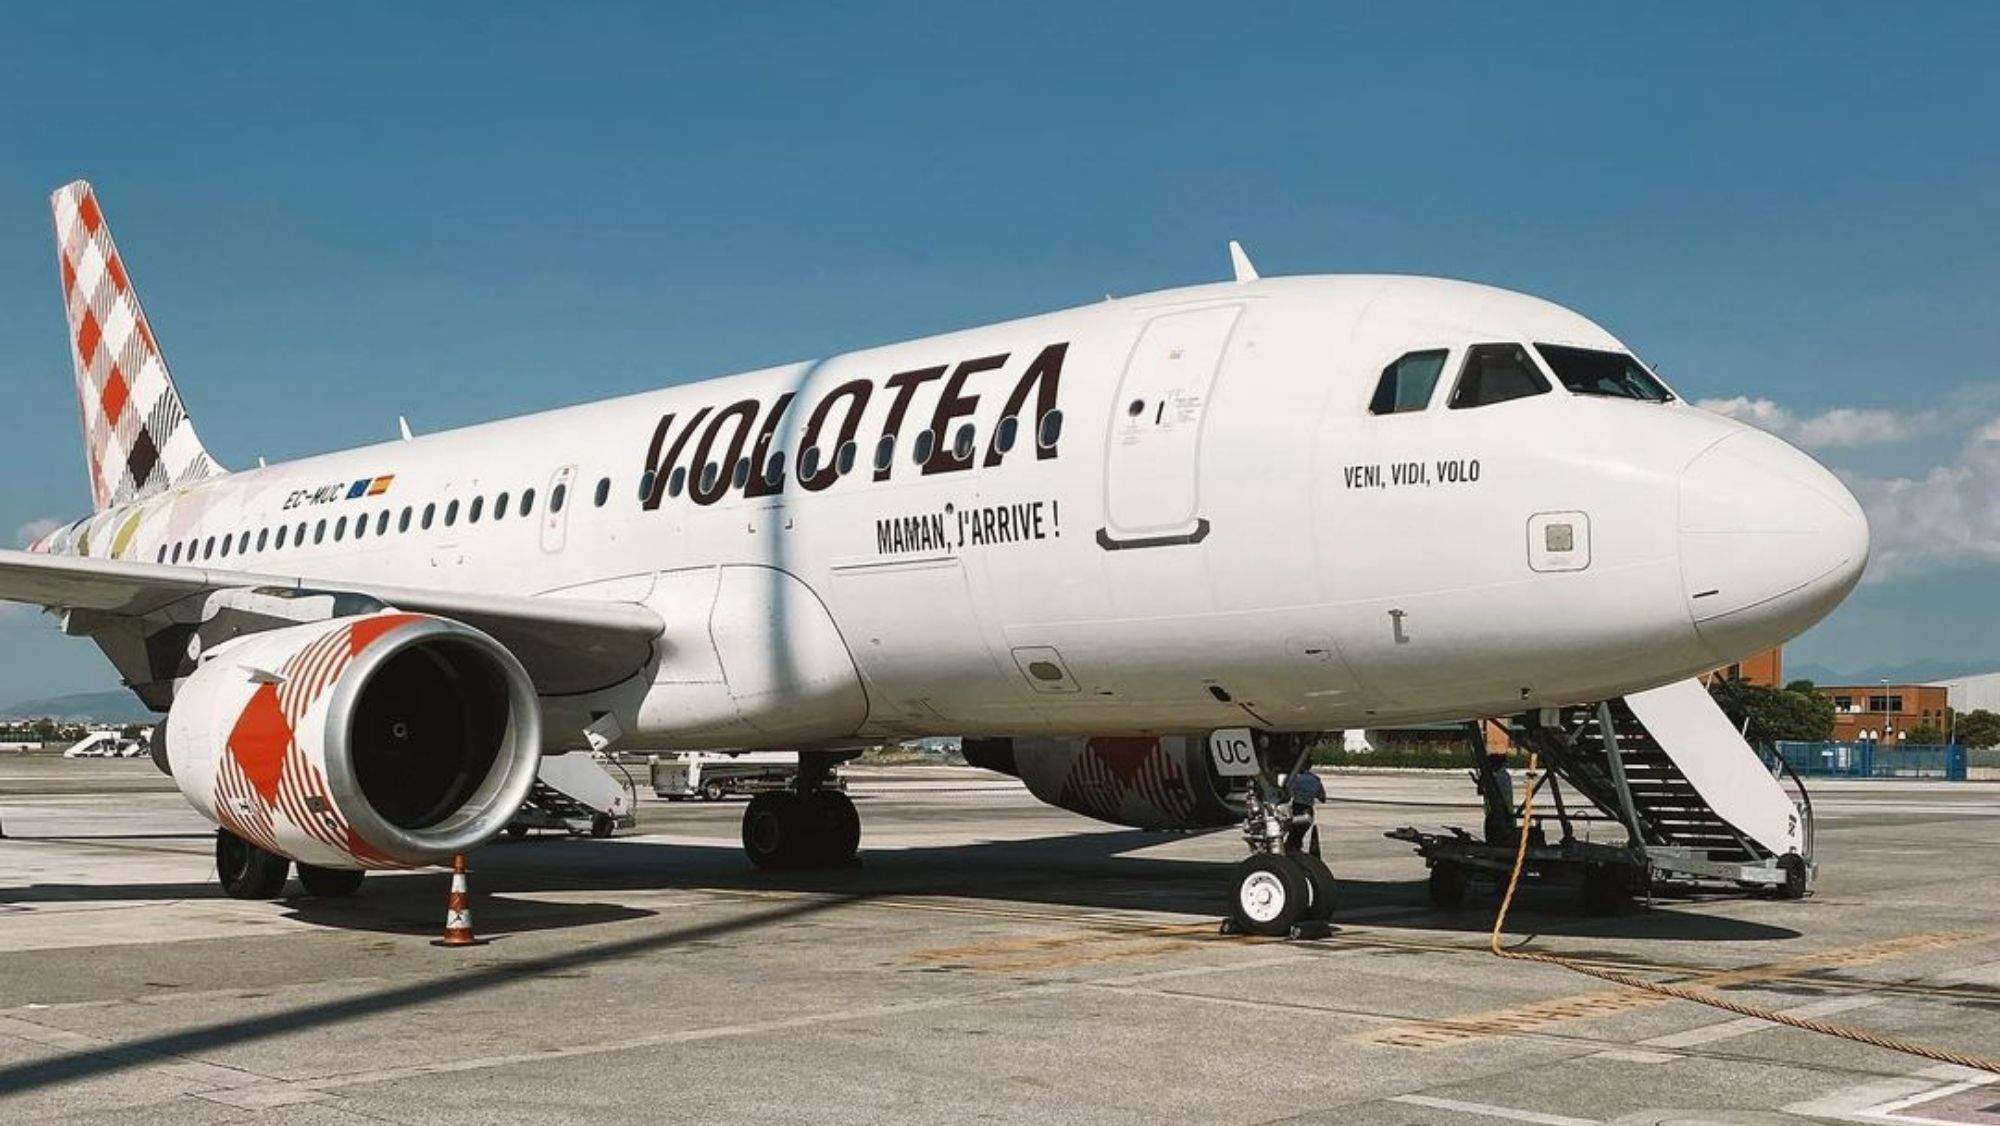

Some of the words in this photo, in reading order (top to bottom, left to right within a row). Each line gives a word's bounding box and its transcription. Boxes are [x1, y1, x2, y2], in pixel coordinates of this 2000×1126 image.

[642, 342, 1070, 512] VOLOTEA
[1344, 464, 1386, 489] VENI,
[1391, 462, 1431, 487] VIDI,
[1436, 459, 1481, 483] VOLO
[876, 512, 952, 555] MAMAN,
[957, 501, 1046, 548] J'ARRIVE
[1053, 499, 1061, 538] !
[1216, 739, 1251, 764] UC
